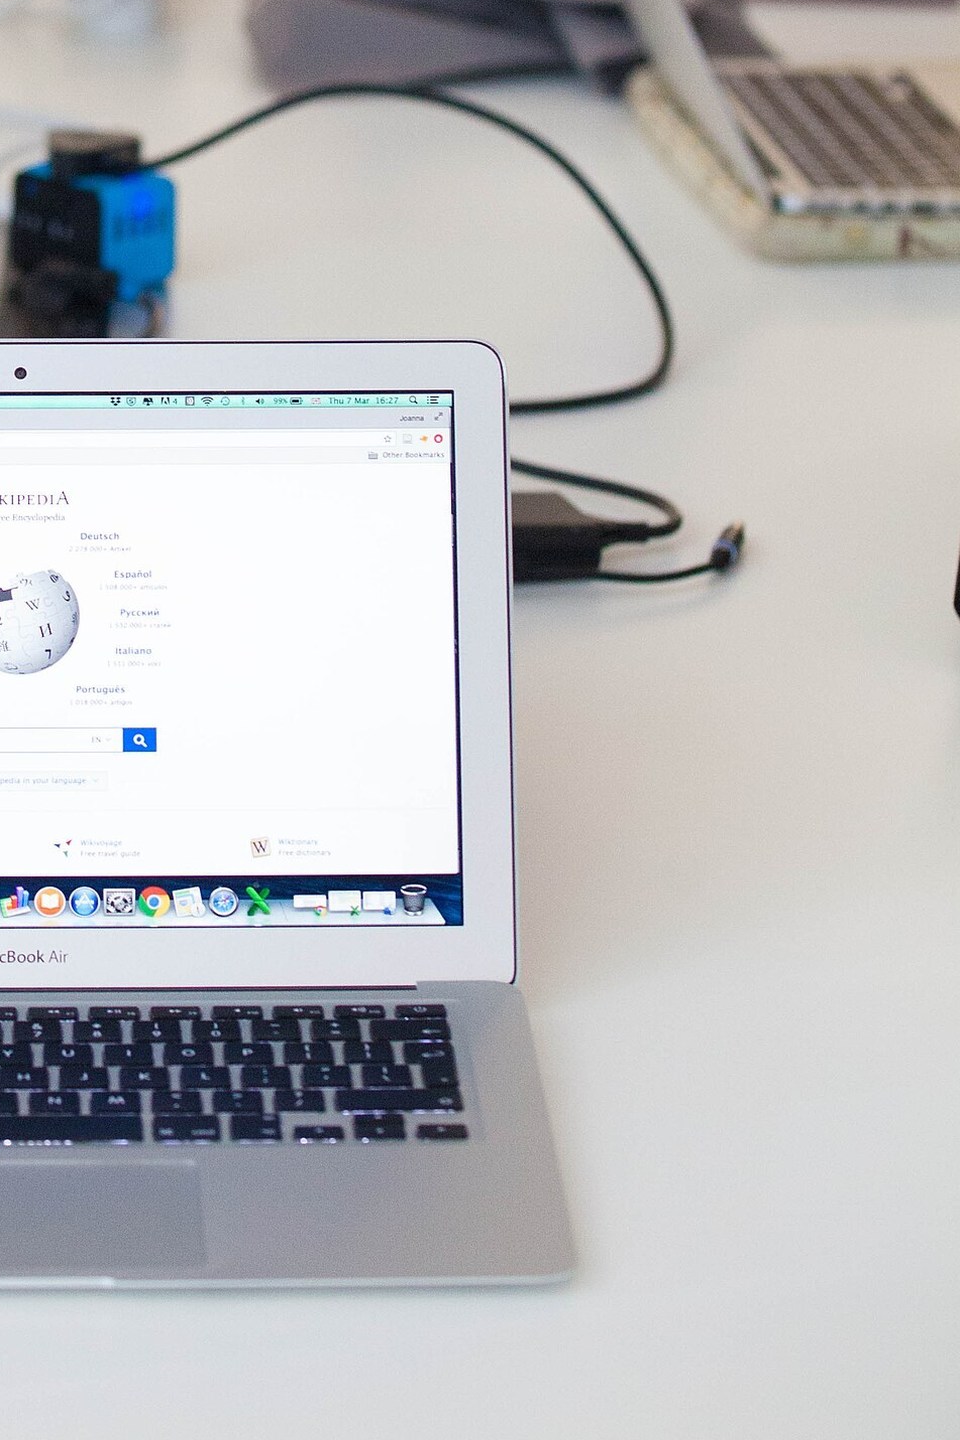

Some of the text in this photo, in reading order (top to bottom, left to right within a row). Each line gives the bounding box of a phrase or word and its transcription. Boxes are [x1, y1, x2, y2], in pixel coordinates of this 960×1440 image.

[12, 513, 66, 522] Encyclopedia
[80, 532, 119, 540] Deutsch
[114, 570, 152, 579] Español
[120, 608, 160, 618] Русский
[115, 647, 152, 655] Italiano
[76, 685, 125, 695] Português
[252, 840, 268, 854] W
[48, 950, 68, 964] Air
